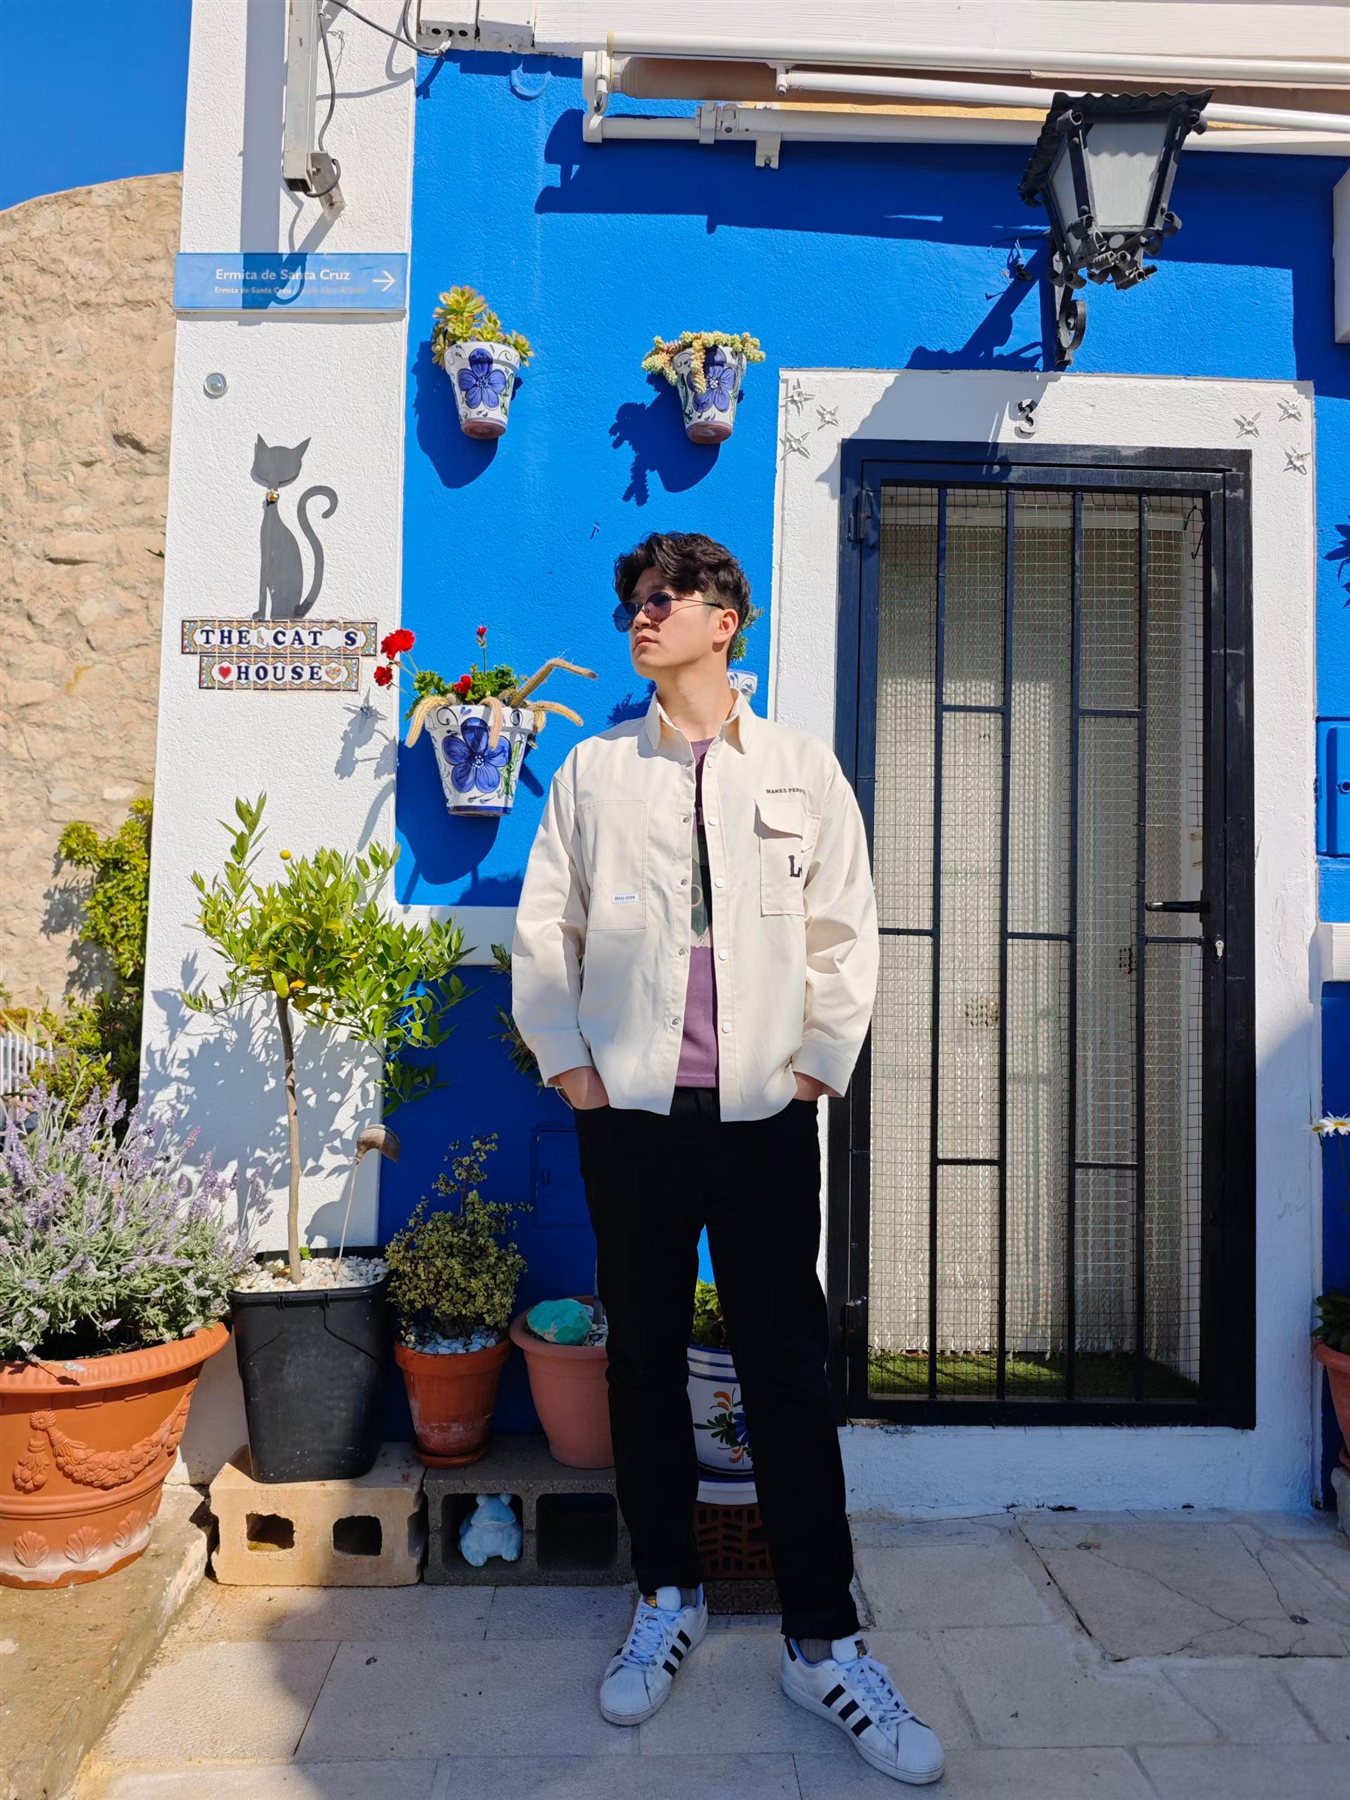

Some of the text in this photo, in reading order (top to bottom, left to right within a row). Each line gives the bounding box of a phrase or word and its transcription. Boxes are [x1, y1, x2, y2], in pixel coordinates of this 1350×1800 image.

[215, 268, 350, 280] Ermita de Santa Cruz
[214, 286, 238, 294] Ermita
[251, 286, 272, 294] Santa
[1017, 398, 1037, 434] 3
[200, 629, 251, 645] THE
[272, 630, 323, 646] CAT
[236, 665, 322, 681] HOUSE
